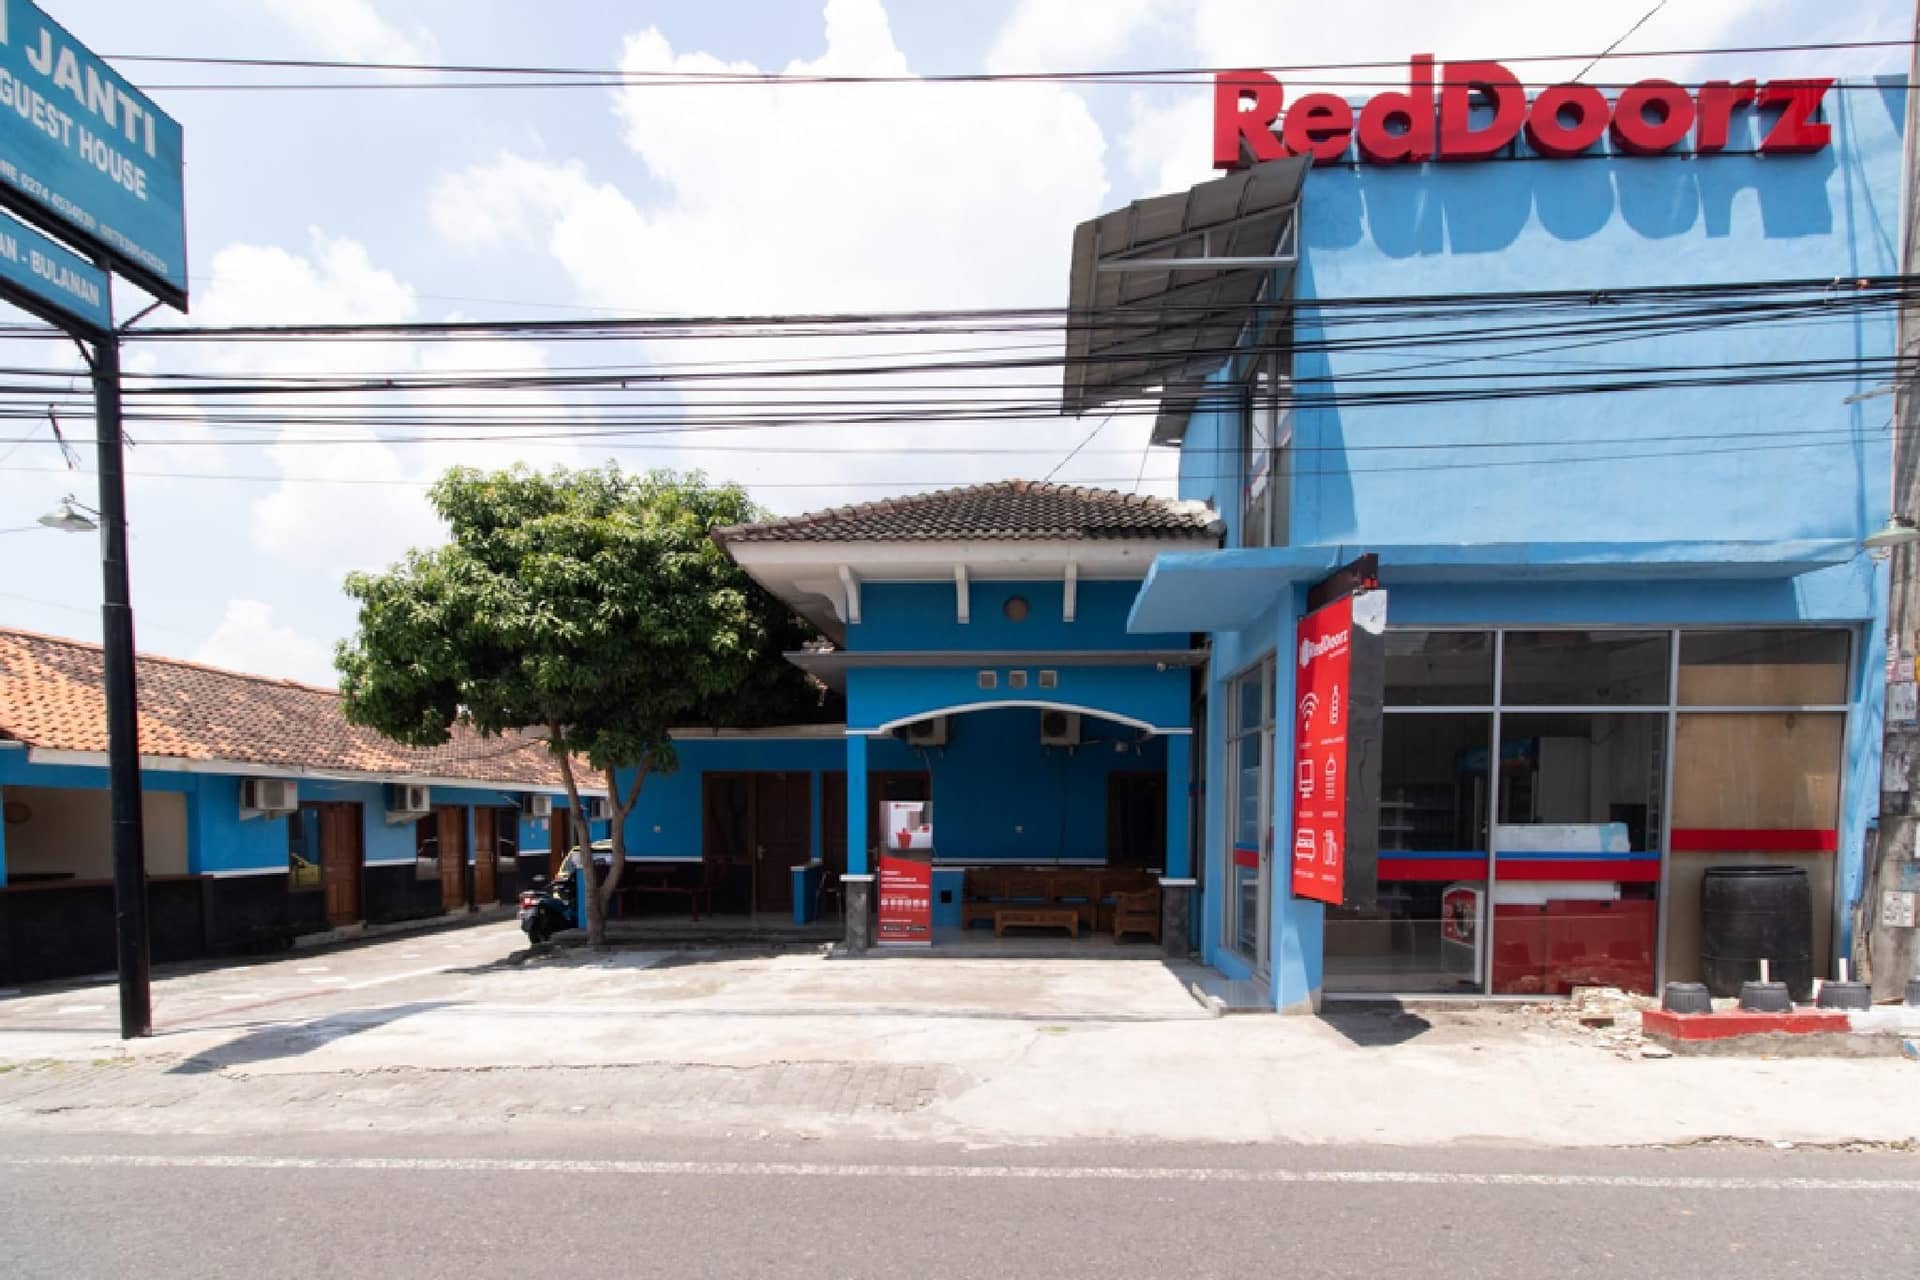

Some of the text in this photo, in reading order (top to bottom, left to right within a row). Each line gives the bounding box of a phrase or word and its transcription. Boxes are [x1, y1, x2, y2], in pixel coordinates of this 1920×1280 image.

[0, 67, 147, 201] GUEST HOUSE
[25, 27, 156, 158] JANTI
[1213, 53, 1836, 169] RedDoorz
